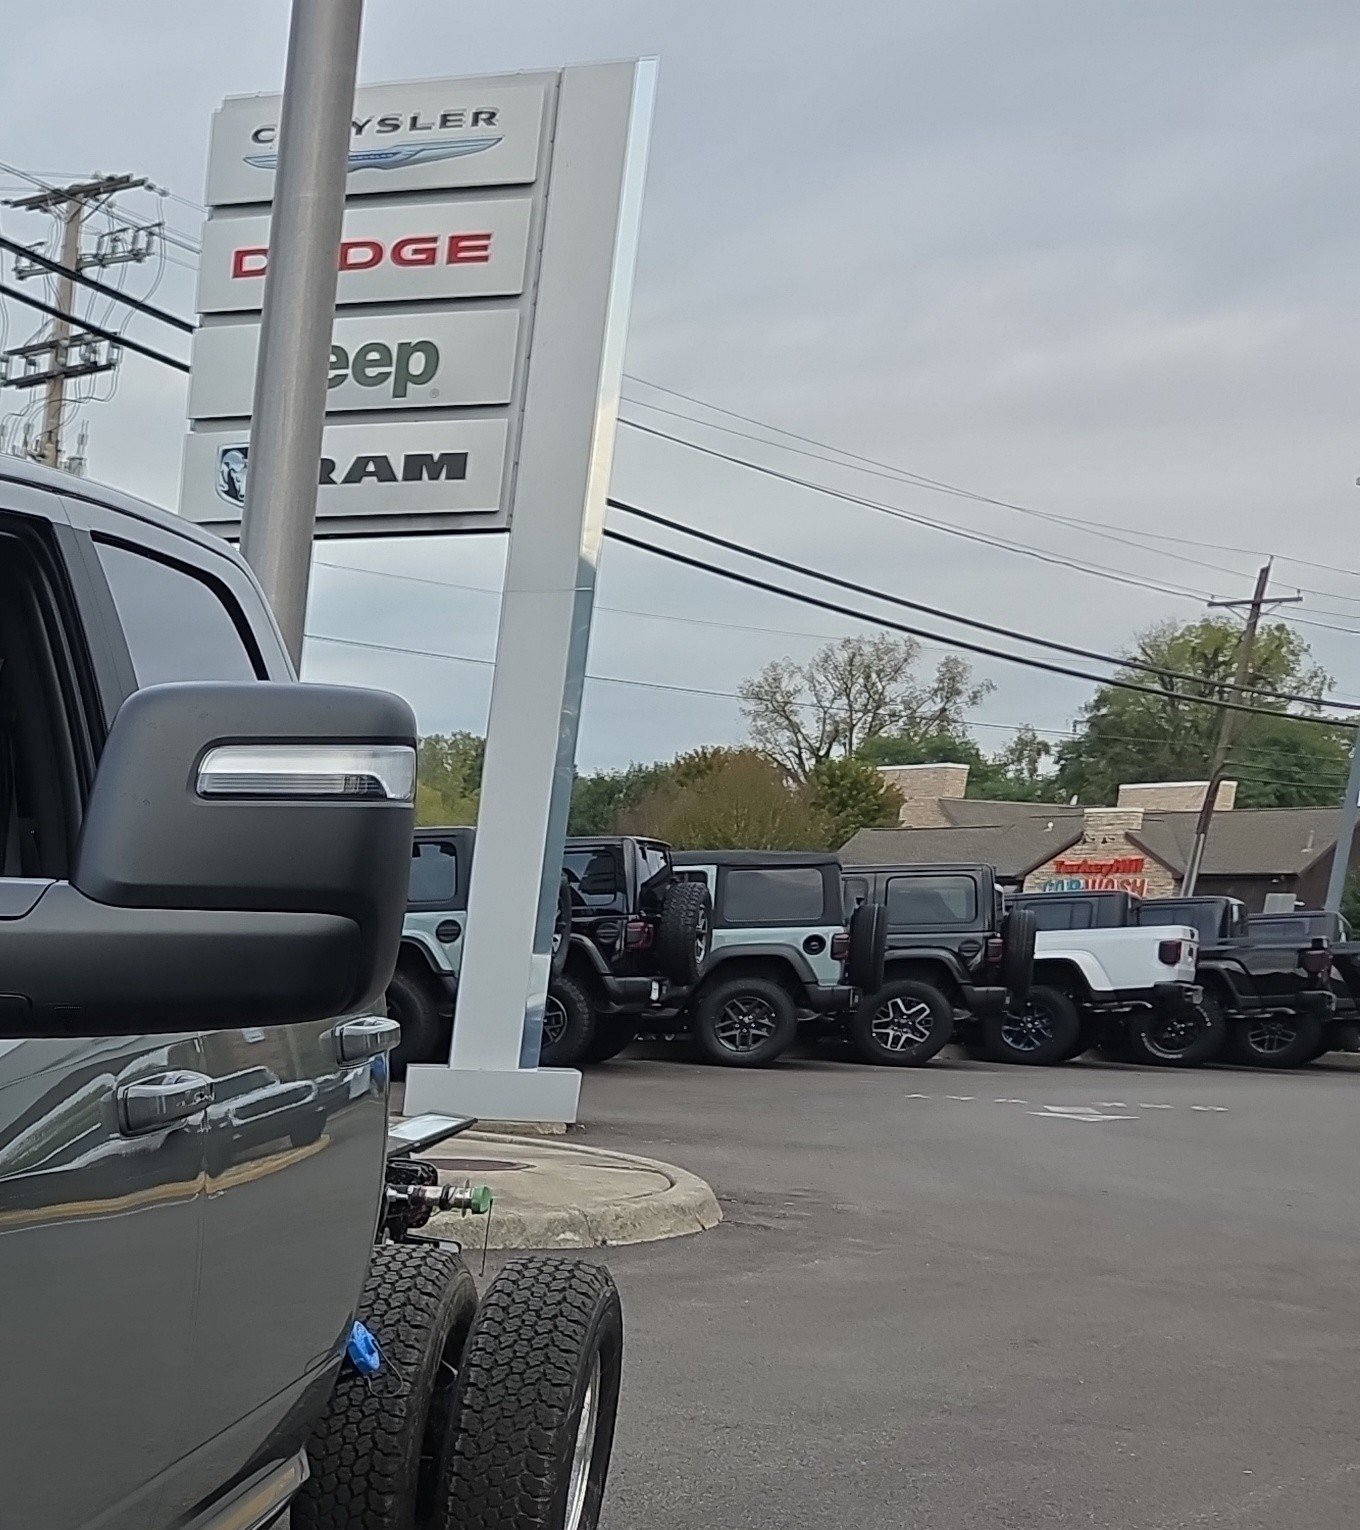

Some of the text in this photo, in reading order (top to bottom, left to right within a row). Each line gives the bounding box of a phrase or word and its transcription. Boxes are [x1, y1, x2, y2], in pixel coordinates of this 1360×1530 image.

[251, 107, 499, 144] CYSLER
[232, 232, 493, 279] DDGE
[327, 340, 440, 398] eep
